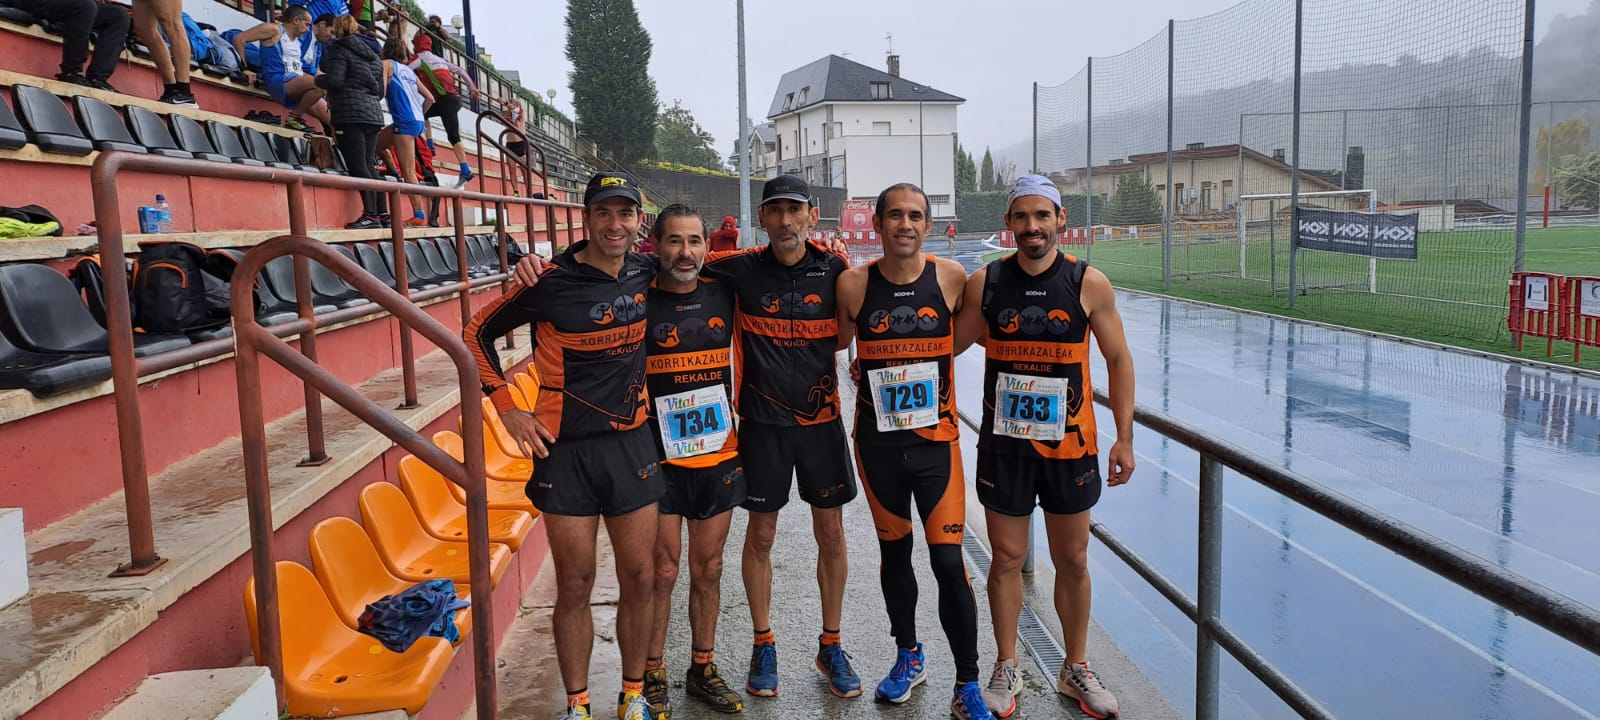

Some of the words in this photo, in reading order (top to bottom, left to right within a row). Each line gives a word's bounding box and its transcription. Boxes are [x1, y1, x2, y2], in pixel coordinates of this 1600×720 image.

[601, 177, 627, 188] BKT
[1013, 362, 1053, 373] REKALDE
[674, 371, 723, 384] REKALDE
[877, 369, 907, 383] Vital
[1005, 376, 1035, 391] Vital
[664, 393, 696, 410] Vital
[885, 383, 928, 412] 729
[1008, 394, 1050, 422] 733
[674, 406, 719, 438] 734
[885, 413, 913, 428] Vital
[1002, 420, 1032, 435] Vital
[673, 438, 705, 455] Vital
